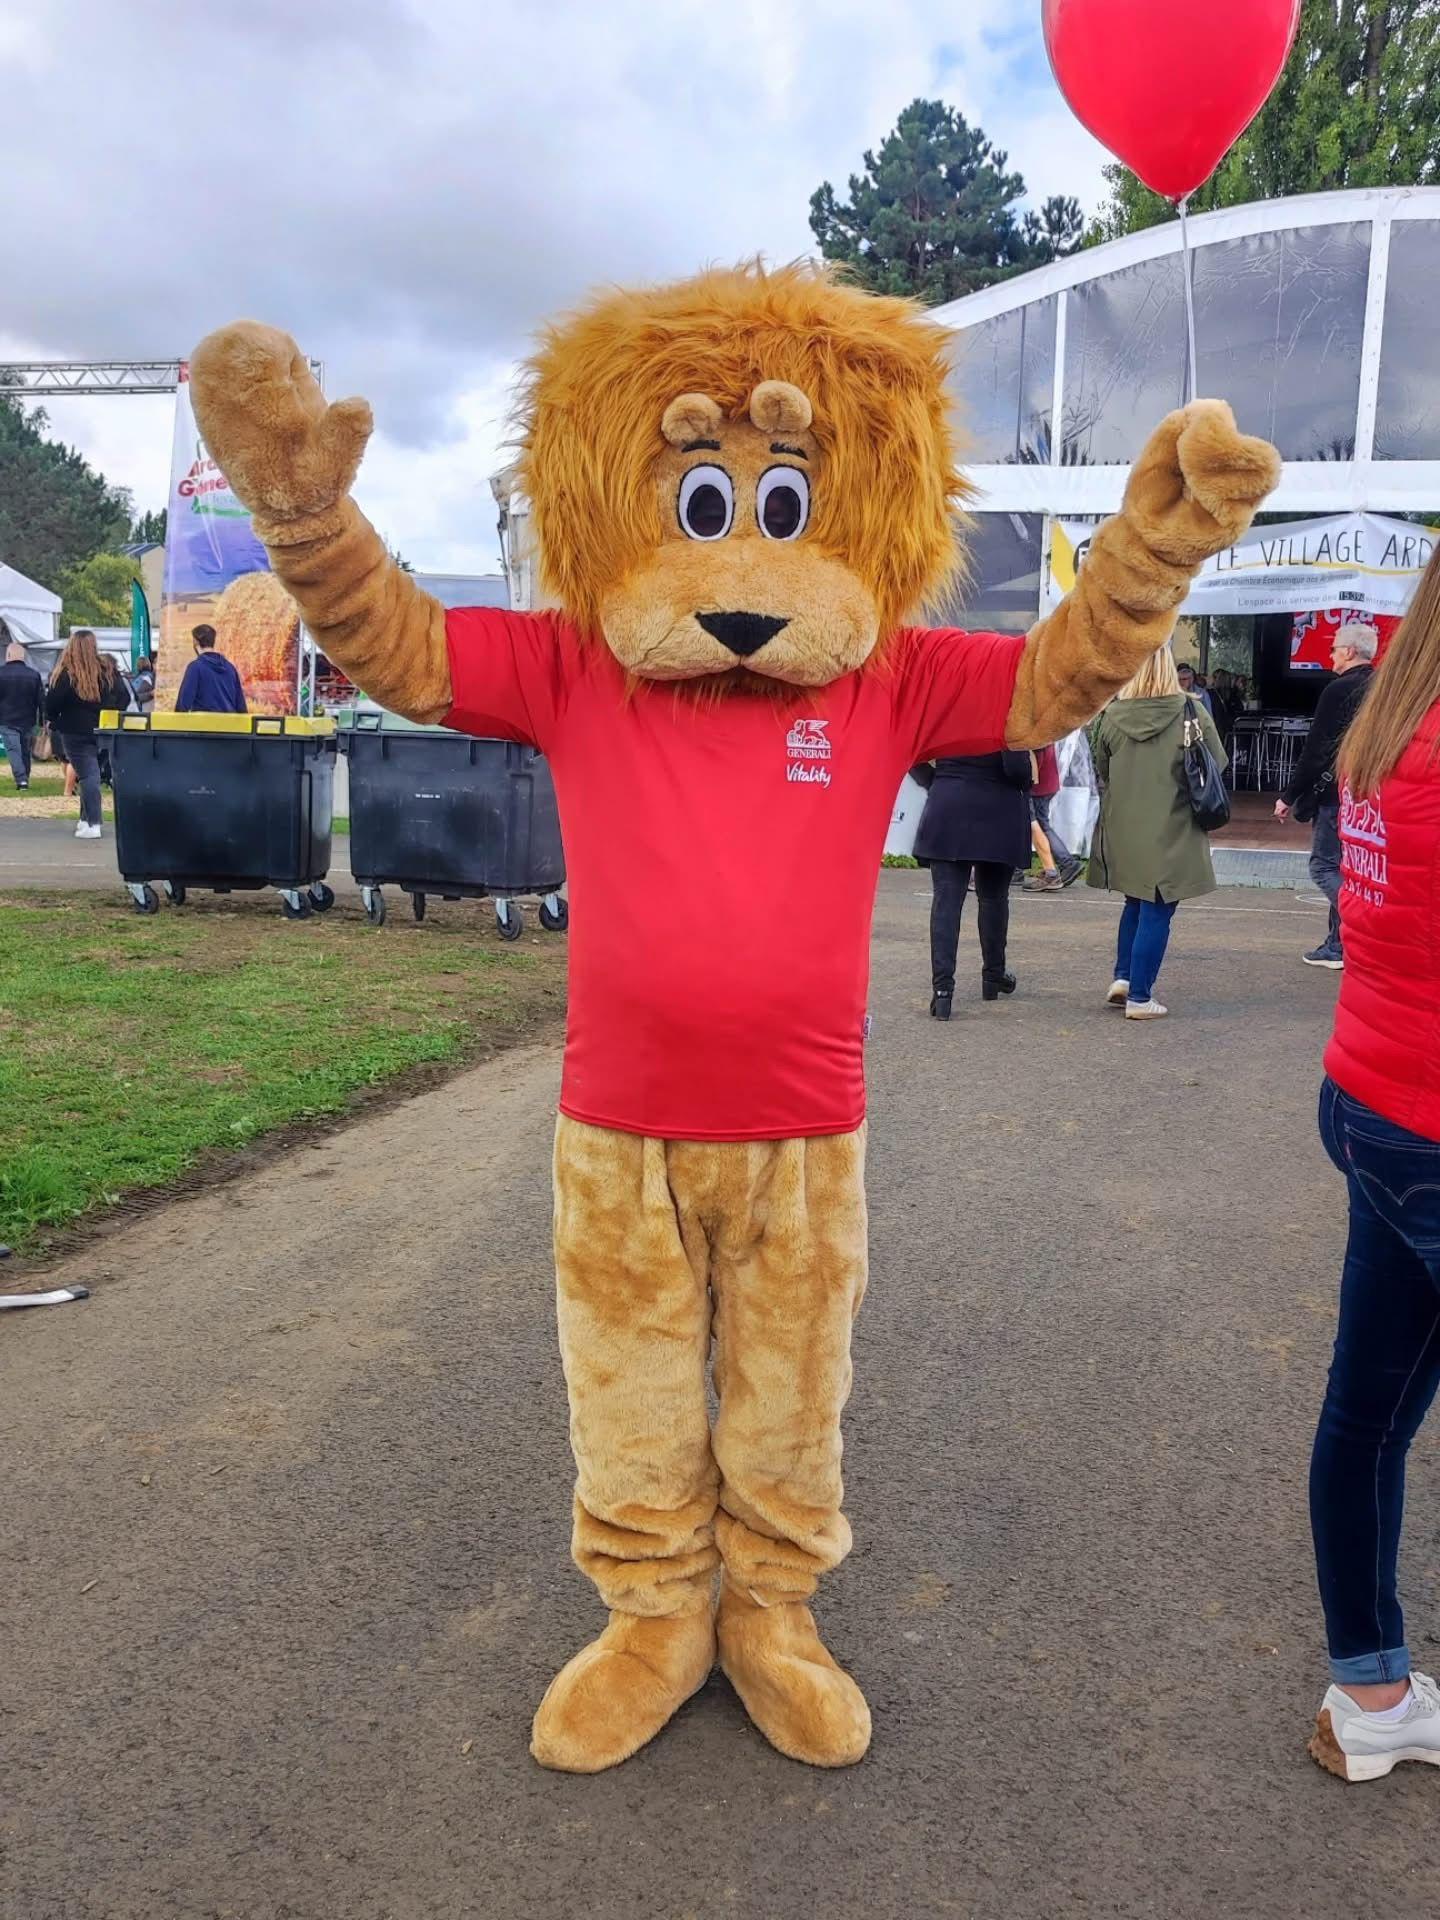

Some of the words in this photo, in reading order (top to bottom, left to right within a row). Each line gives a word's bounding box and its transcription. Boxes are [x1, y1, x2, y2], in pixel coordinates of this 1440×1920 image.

[1217, 546, 1242, 571] LE
[1260, 530, 1364, 567] VILLAGE
[1380, 533, 1434, 569] ARD
[787, 748, 831, 759] GENERALI
[786, 761, 831, 788] Vitality
